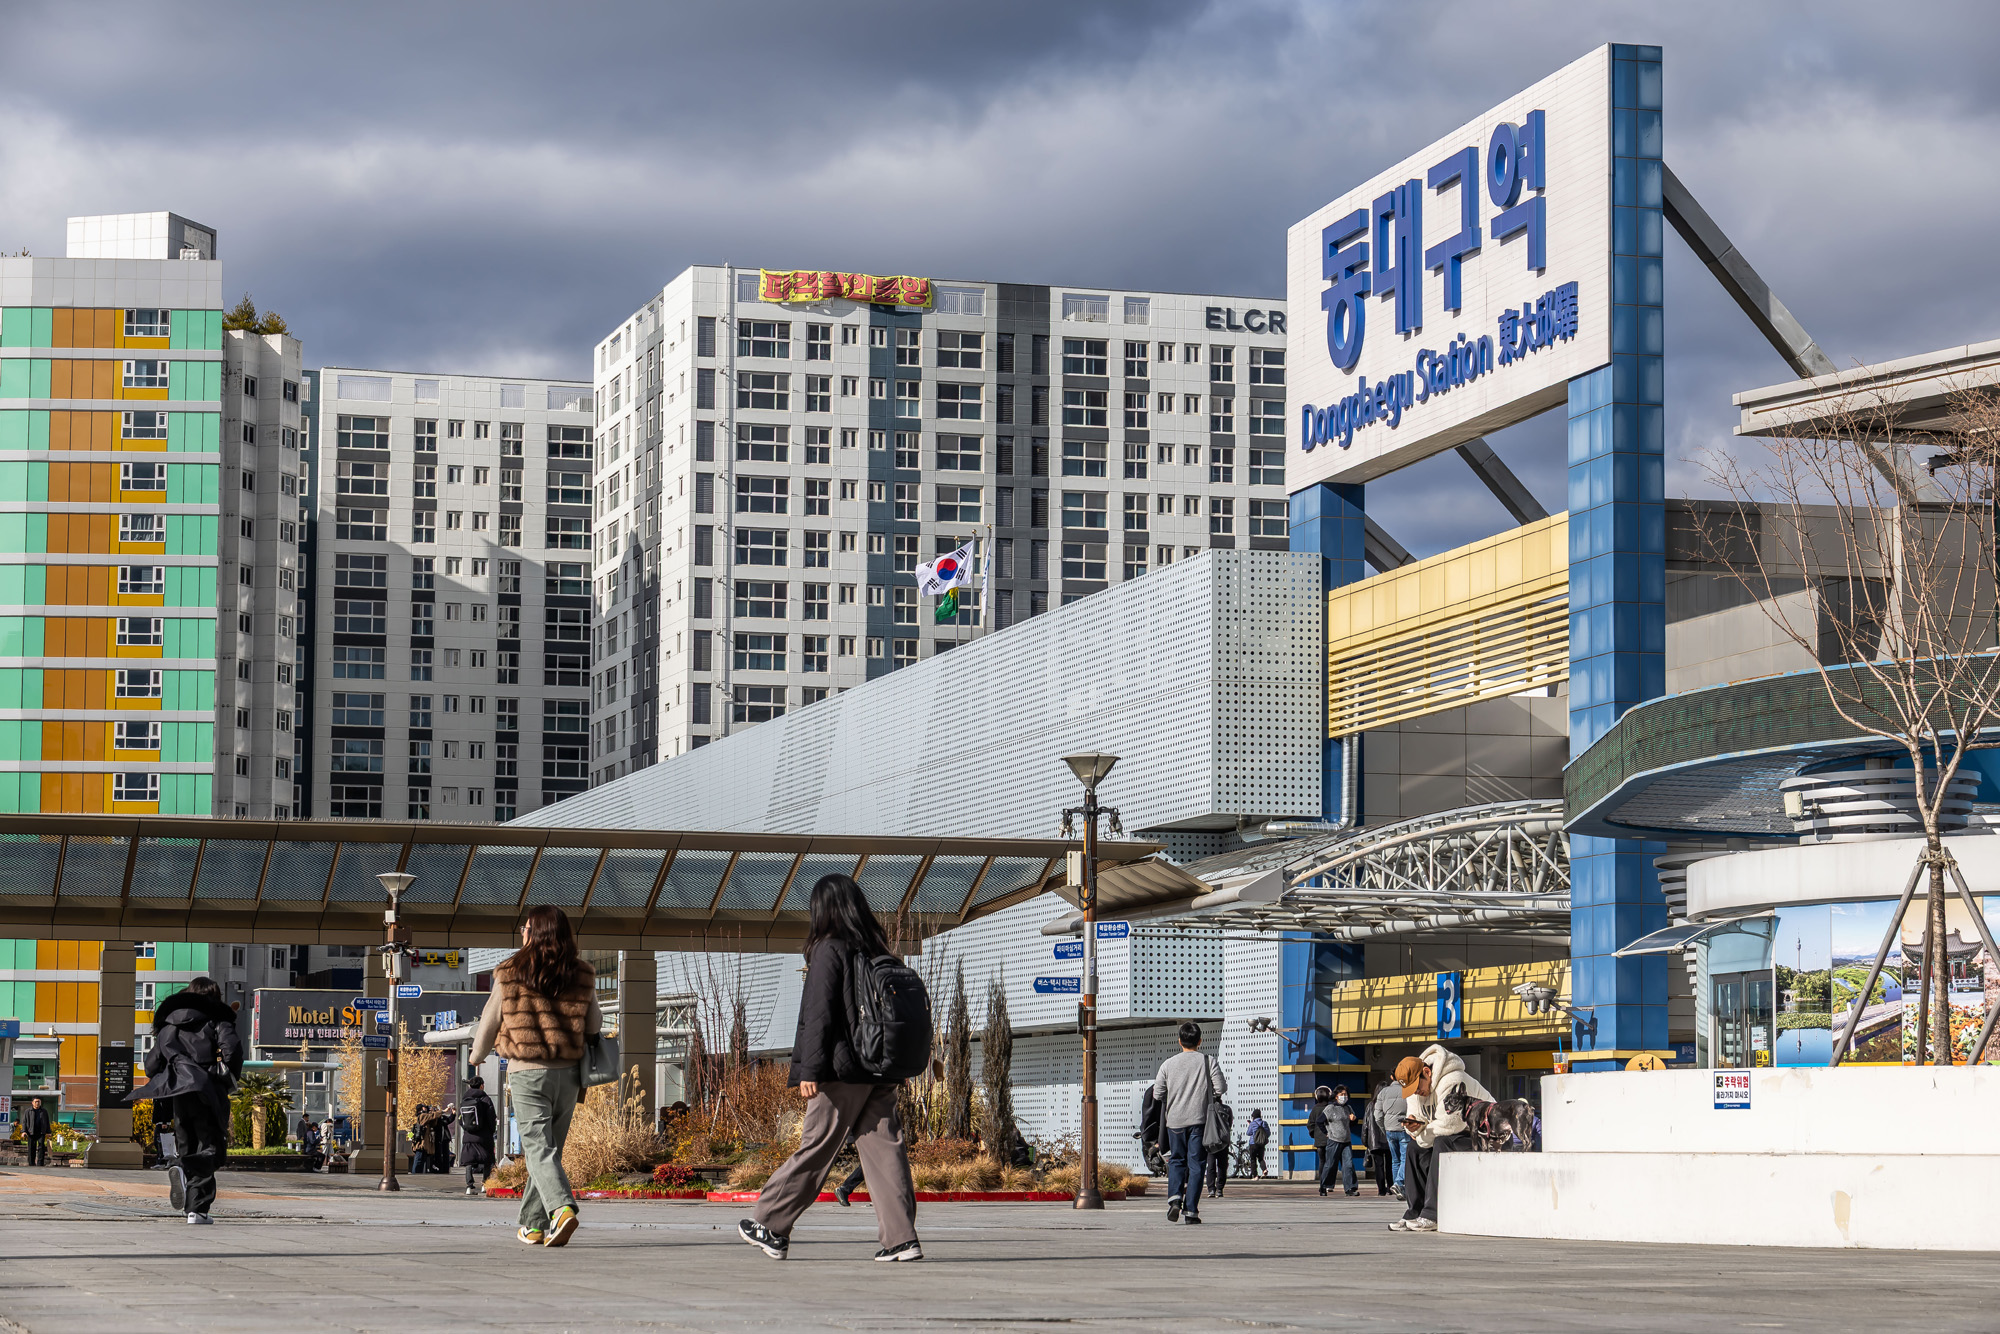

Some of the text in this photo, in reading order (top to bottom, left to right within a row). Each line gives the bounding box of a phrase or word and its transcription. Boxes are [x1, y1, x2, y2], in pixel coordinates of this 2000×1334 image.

[1321, 109, 1546, 369] 동대구역
[1498, 281, 1578, 366] 東大邱驛
[1302, 333, 1493, 450] Dongdaegu Station
[424, 951, 459, 968] 모텔
[288, 1006, 334, 1025] Motel
[1442, 978, 1457, 1033] 3
[1716, 1091, 1749, 1099] 올라가지 마시오
[1725, 1076, 1749, 1088] 추락위험
